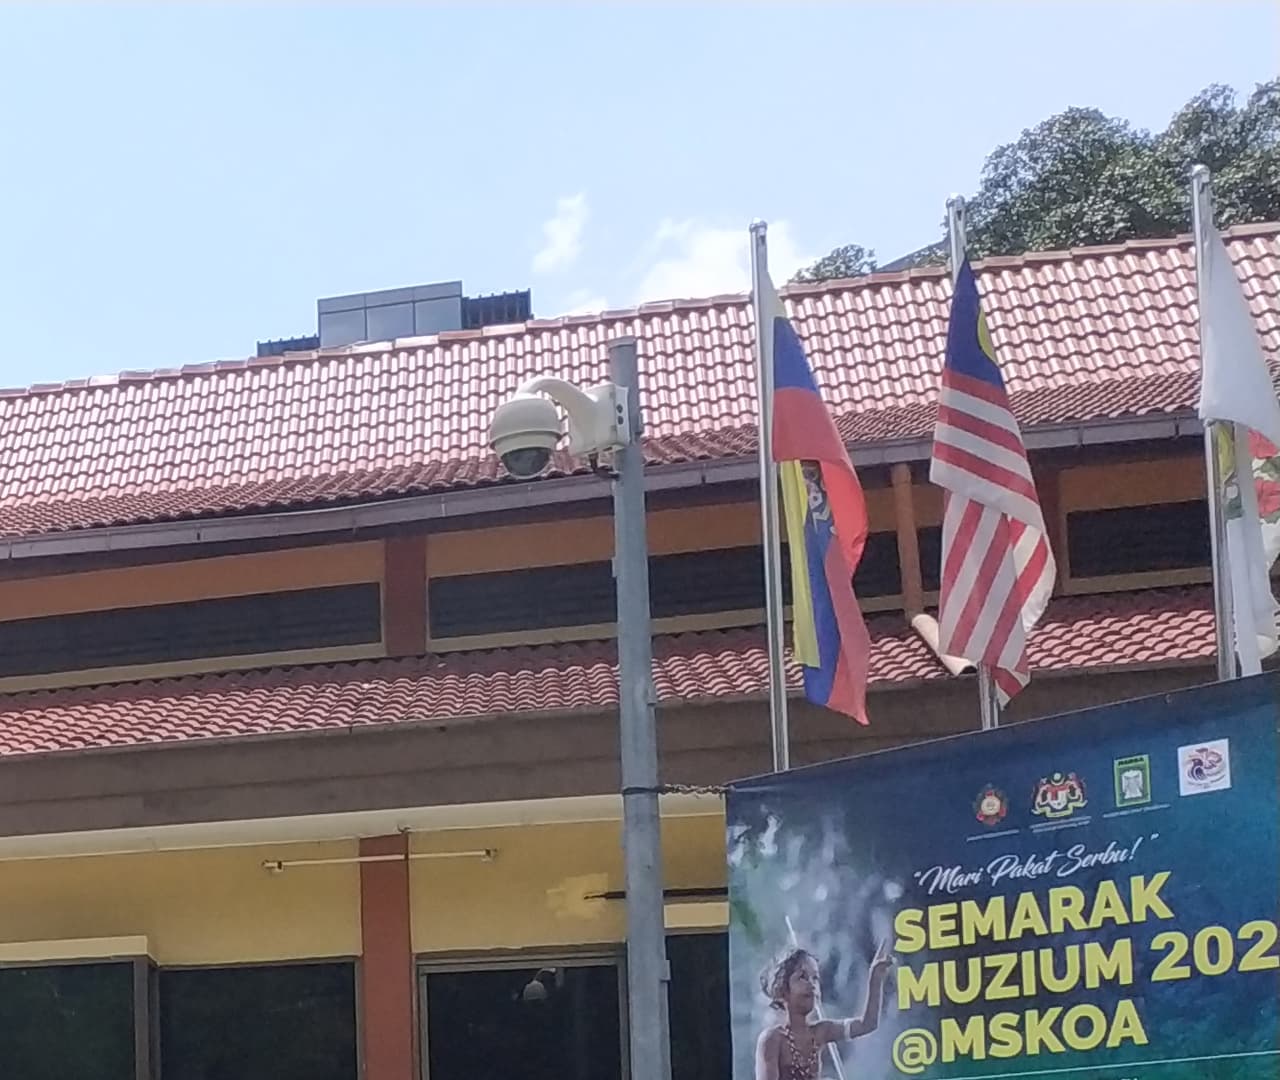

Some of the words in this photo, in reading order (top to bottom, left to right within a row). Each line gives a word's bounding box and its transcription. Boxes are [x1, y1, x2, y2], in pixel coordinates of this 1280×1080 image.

[987, 850, 1058, 887] Pakat
[894, 871, 1175, 954] SEMARAK
[896, 938, 1134, 1010] MUZIUM
[1150, 919, 1280, 982] 202
[892, 999, 1149, 1075] @MSKOA
